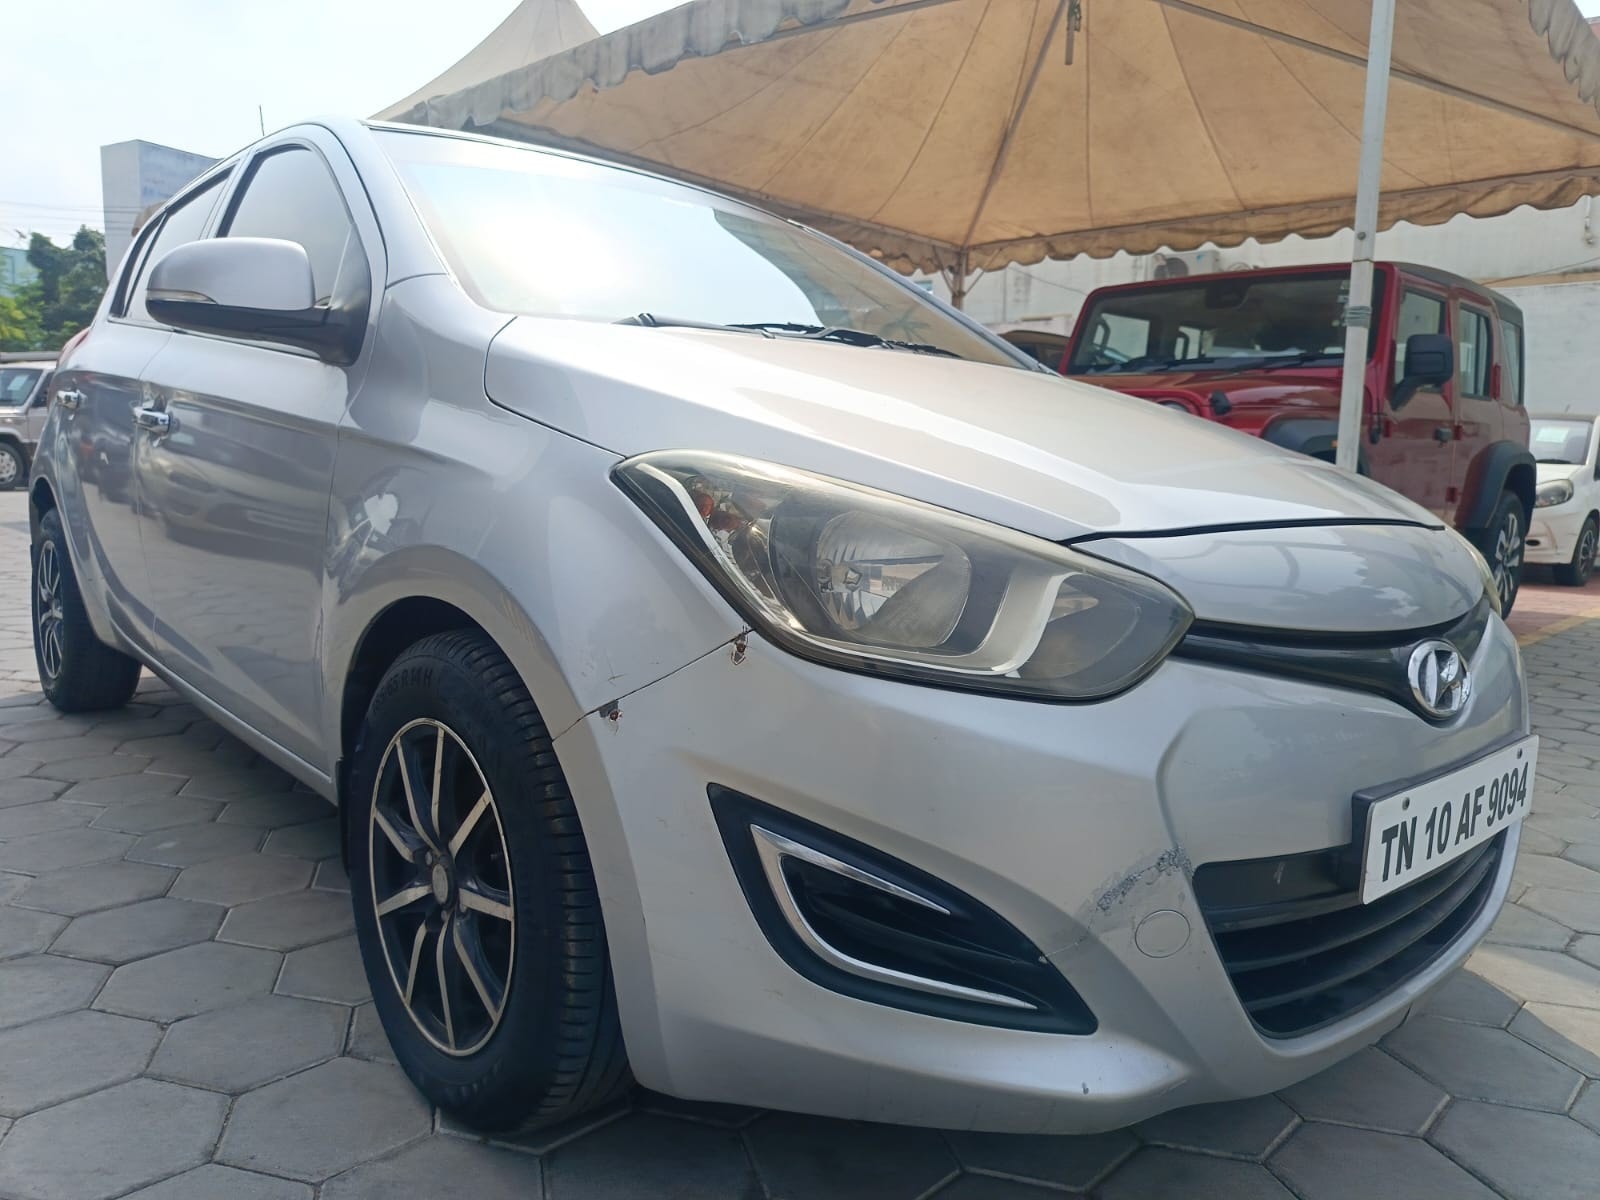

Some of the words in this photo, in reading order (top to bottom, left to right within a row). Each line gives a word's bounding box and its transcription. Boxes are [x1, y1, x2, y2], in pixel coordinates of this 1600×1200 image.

[1382, 816, 1417, 882] TN
[1425, 801, 1451, 860] 10
[1455, 785, 1485, 846] AF
[1487, 762, 1528, 827] 9094
